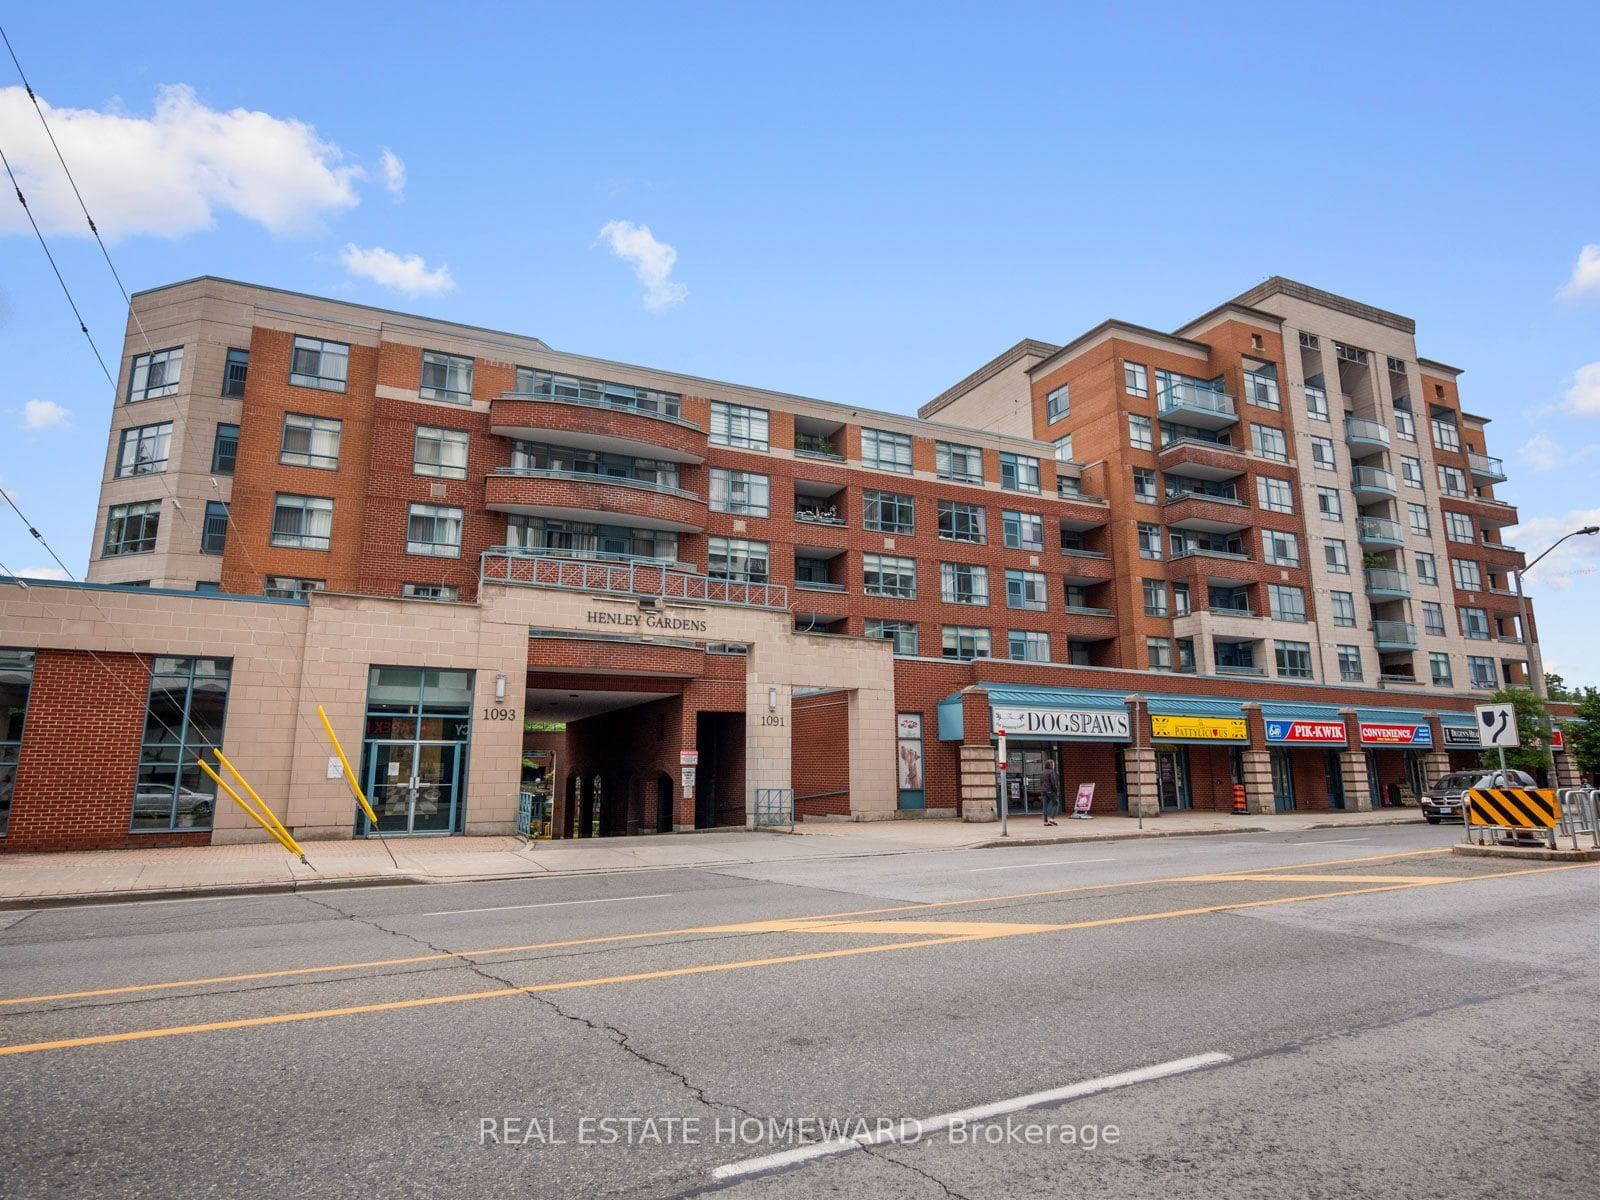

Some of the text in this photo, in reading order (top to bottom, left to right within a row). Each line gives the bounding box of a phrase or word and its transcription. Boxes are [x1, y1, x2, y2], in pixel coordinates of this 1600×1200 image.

[587, 611, 707, 632] HENLEY GARDENS
[483, 708, 516, 721] 1093
[761, 715, 784, 727] 1091
[1294, 725, 1343, 738] PIK-KWIK
[1362, 728, 1411, 738] CONVENIENCE
